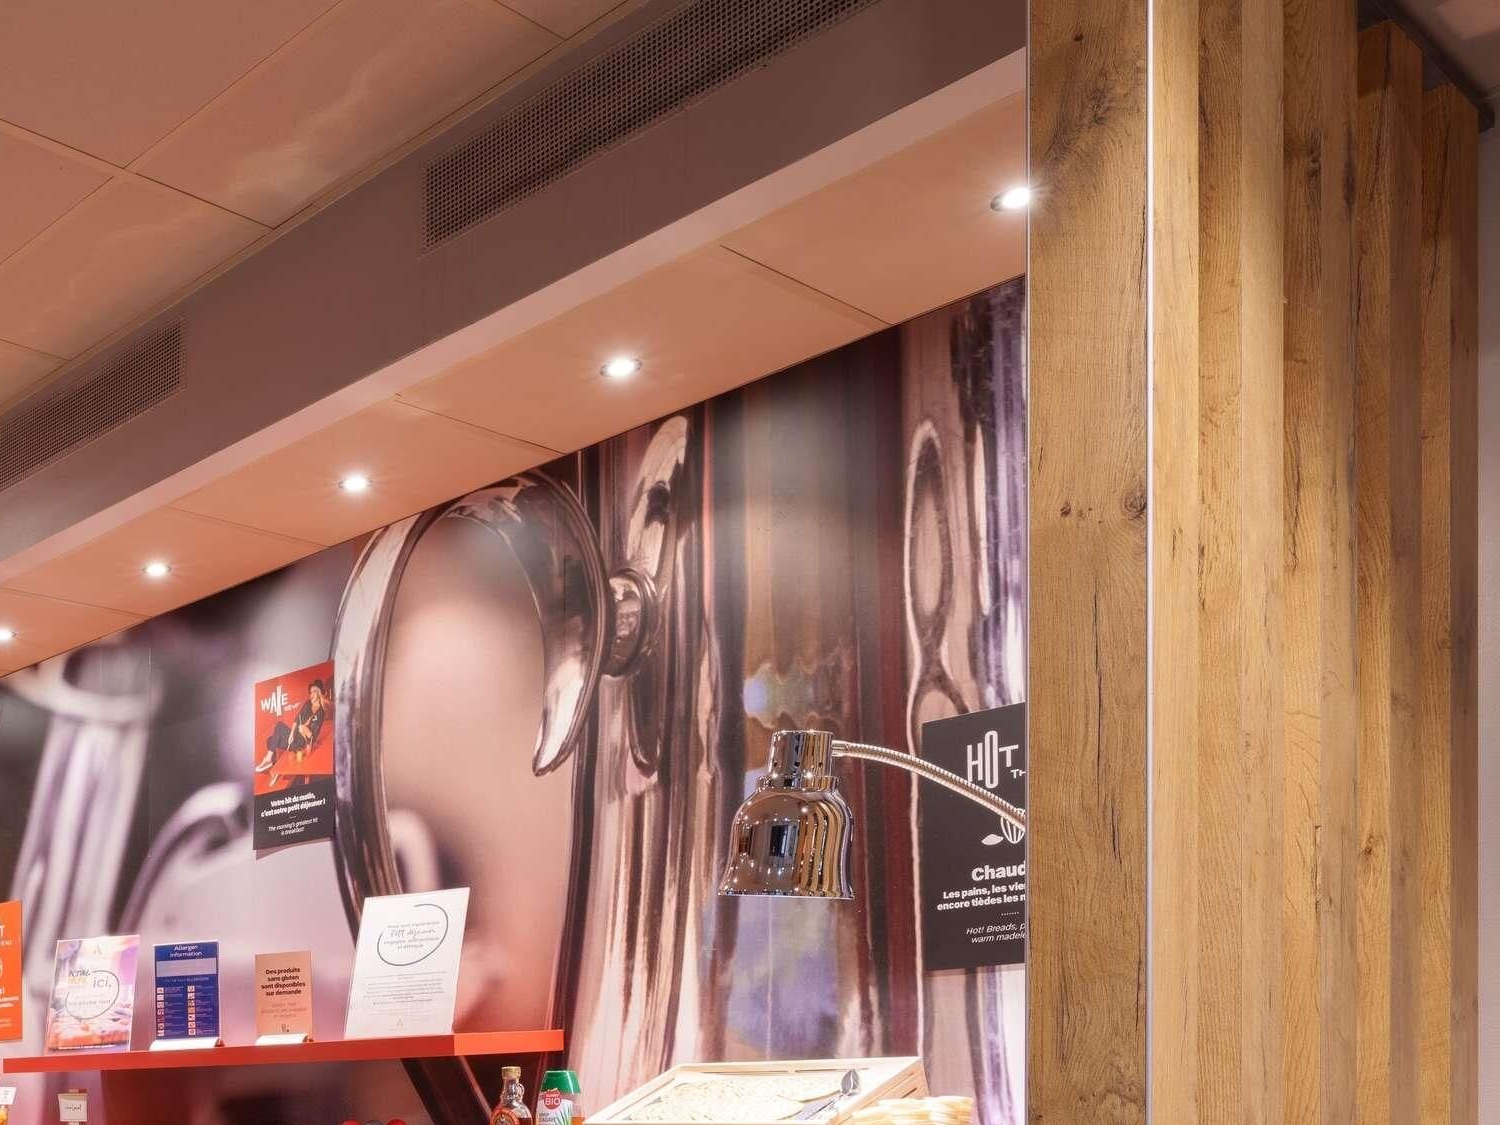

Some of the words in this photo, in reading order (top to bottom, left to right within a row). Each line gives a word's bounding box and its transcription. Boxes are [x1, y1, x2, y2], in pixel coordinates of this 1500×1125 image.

[966, 730, 1019, 789] HOT
[971, 861, 1026, 881] Chaud
[943, 891, 960, 899] Les
[961, 886, 991, 899] pains,
[991, 884, 1007, 893] les
[936, 900, 970, 910] encore
[971, 896, 1002, 906] tièdes
[1003, 894, 1019, 903] les
[966, 926, 985, 935] Hot!
[987, 922, 1018, 933] Breads,
[971, 935, 995, 943] warm
[545, 1097, 561, 1106] BIO
